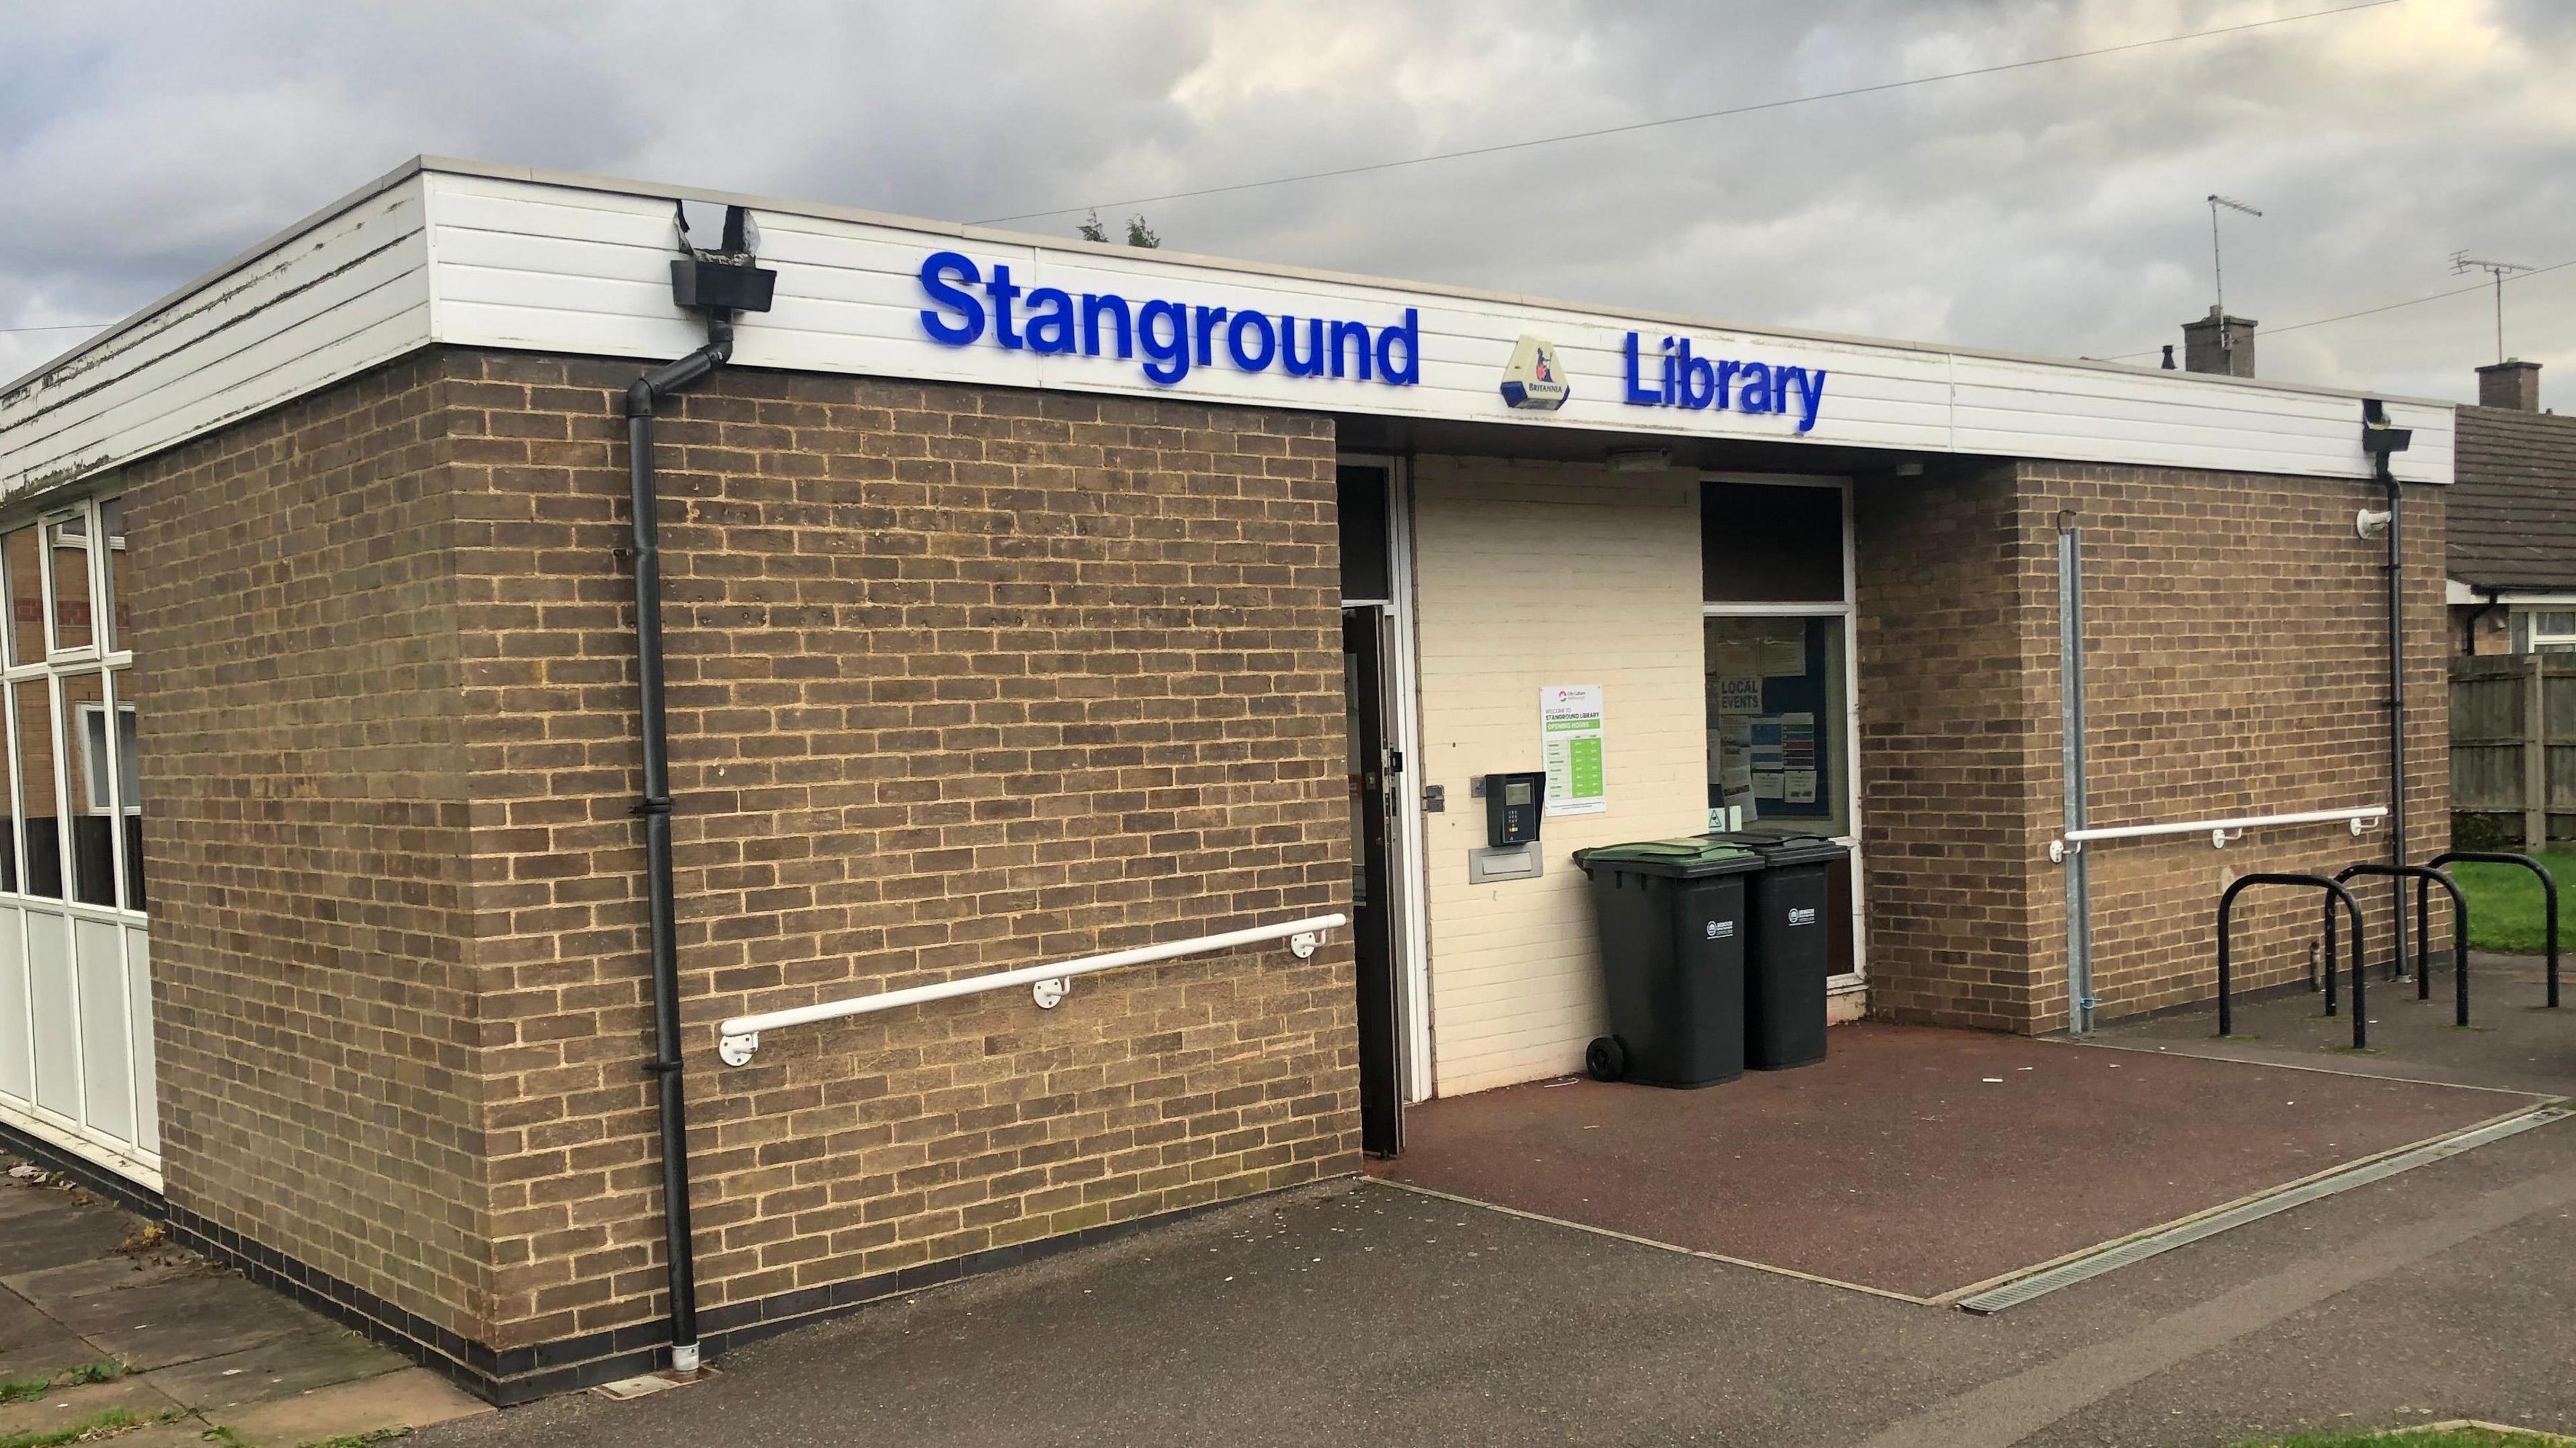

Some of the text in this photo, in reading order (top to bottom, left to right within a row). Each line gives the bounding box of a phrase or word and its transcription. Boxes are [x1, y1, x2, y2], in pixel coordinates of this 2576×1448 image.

[920, 252, 1419, 384] Stanground
[1529, 383, 1562, 393] BRITANNIA
[1626, 332, 1826, 431] Library
[1721, 680, 1758, 694] LOCAL
[1721, 695, 1758, 709] EVENTS
[1548, 722, 1570, 730] OPENING
